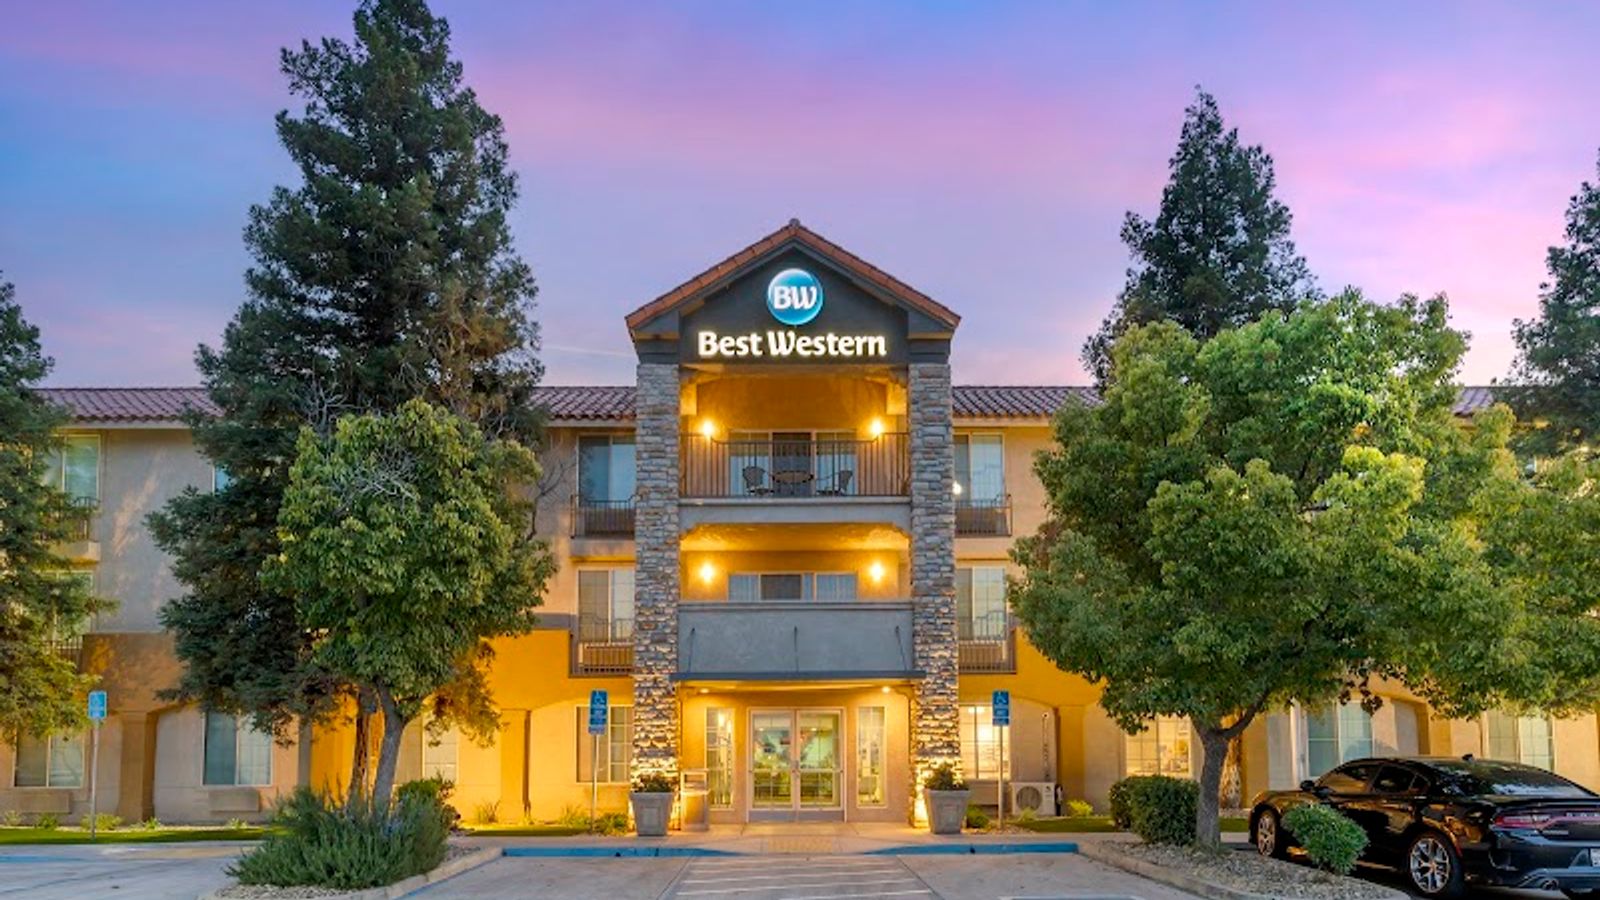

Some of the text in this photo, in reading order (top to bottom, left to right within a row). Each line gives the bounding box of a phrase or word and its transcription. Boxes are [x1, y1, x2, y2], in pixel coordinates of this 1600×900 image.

[773, 285, 818, 310] BW
[698, 330, 887, 356] Best Western
